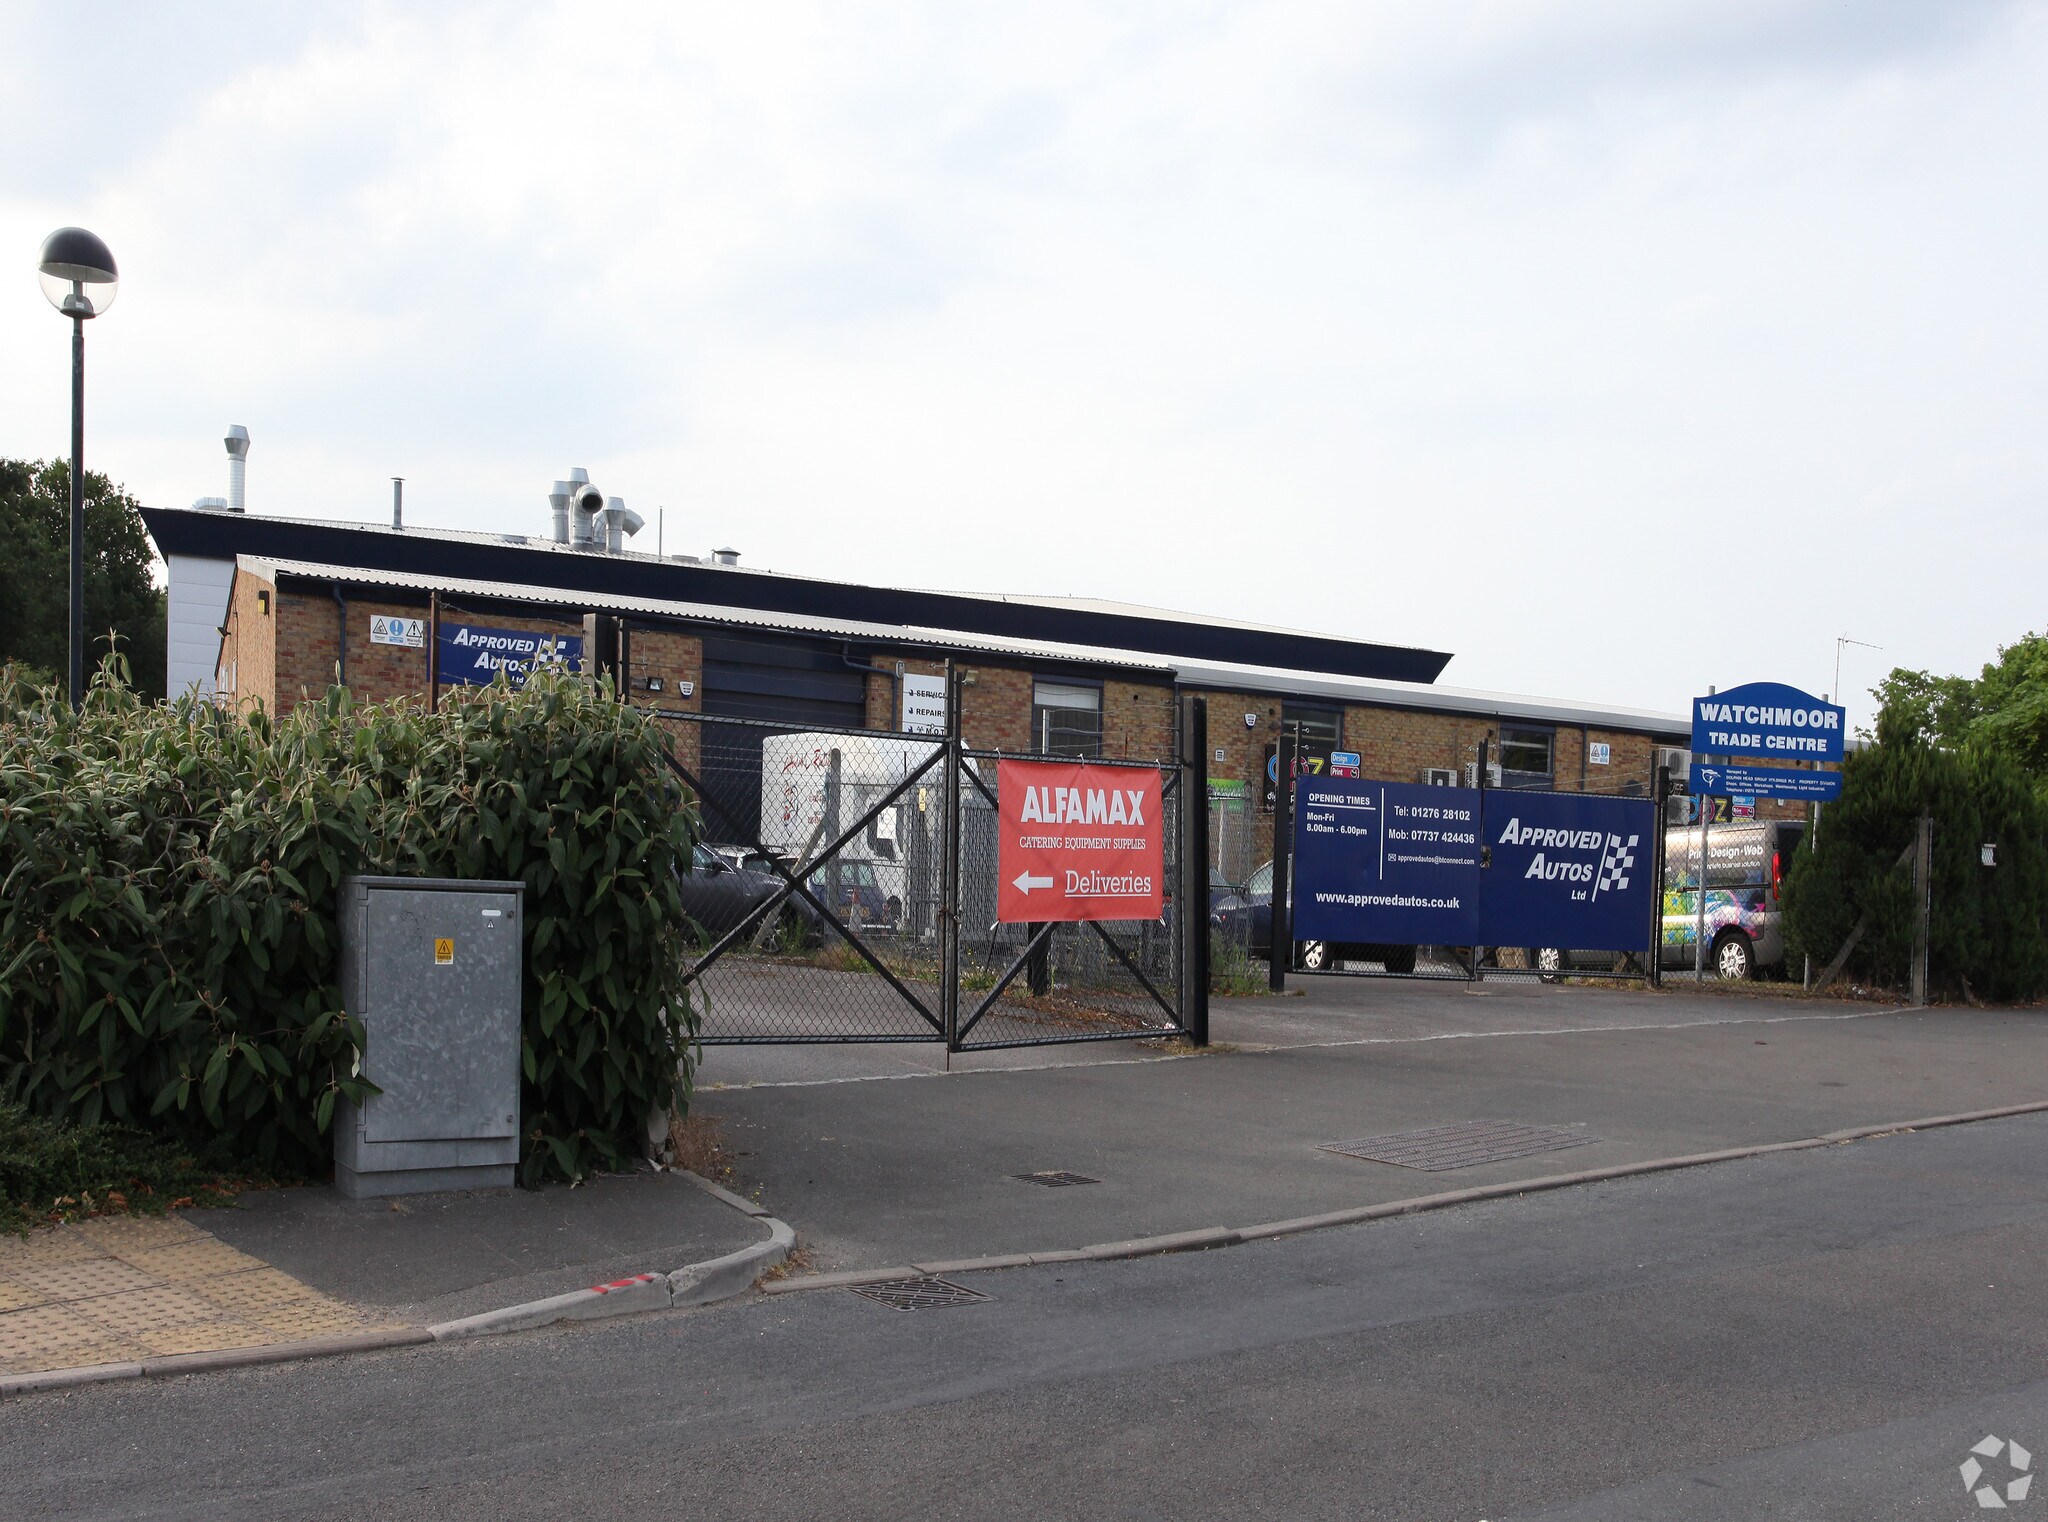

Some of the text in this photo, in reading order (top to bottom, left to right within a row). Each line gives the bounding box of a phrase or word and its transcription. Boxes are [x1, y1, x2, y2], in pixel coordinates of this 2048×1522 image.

[453, 628, 534, 652] APPROVED
[474, 651, 528, 673] AUTOS
[916, 708, 945, 718] REPAIRS
[1700, 702, 1839, 729] WATCHMOOR
[1709, 732, 1828, 752] TRADE CENTRE
[1332, 754, 1348, 764] Design
[1332, 768, 1343, 776] Print
[1021, 786, 1145, 826] ALFAMAX
[1308, 793, 1344, 804] OPENING
[1346, 795, 1370, 806] TIMES
[1306, 812, 1335, 822] Mon-Fri
[1394, 806, 1470, 821] Tel: 01276 28102
[1306, 823, 1334, 834] 8.00am
[1340, 825, 1368, 837] 6.00pm
[1388, 829, 1475, 844] Mob: 07737 424436
[1498, 817, 1602, 850] APPROVED
[1019, 836, 1146, 850] CATERING EQUIPMENT SUPPLIES
[1711, 846, 1740, 859] Design
[1744, 844, 1763, 856] Web
[1397, 853, 1475, 866] approvedautos@btconnect.com
[1524, 853, 1594, 882] AUTOS
[1065, 870, 1151, 894] Deliveries
[1316, 892, 1460, 909] www.approvedautos.co.uk
[1571, 890, 1587, 901] Ltd
